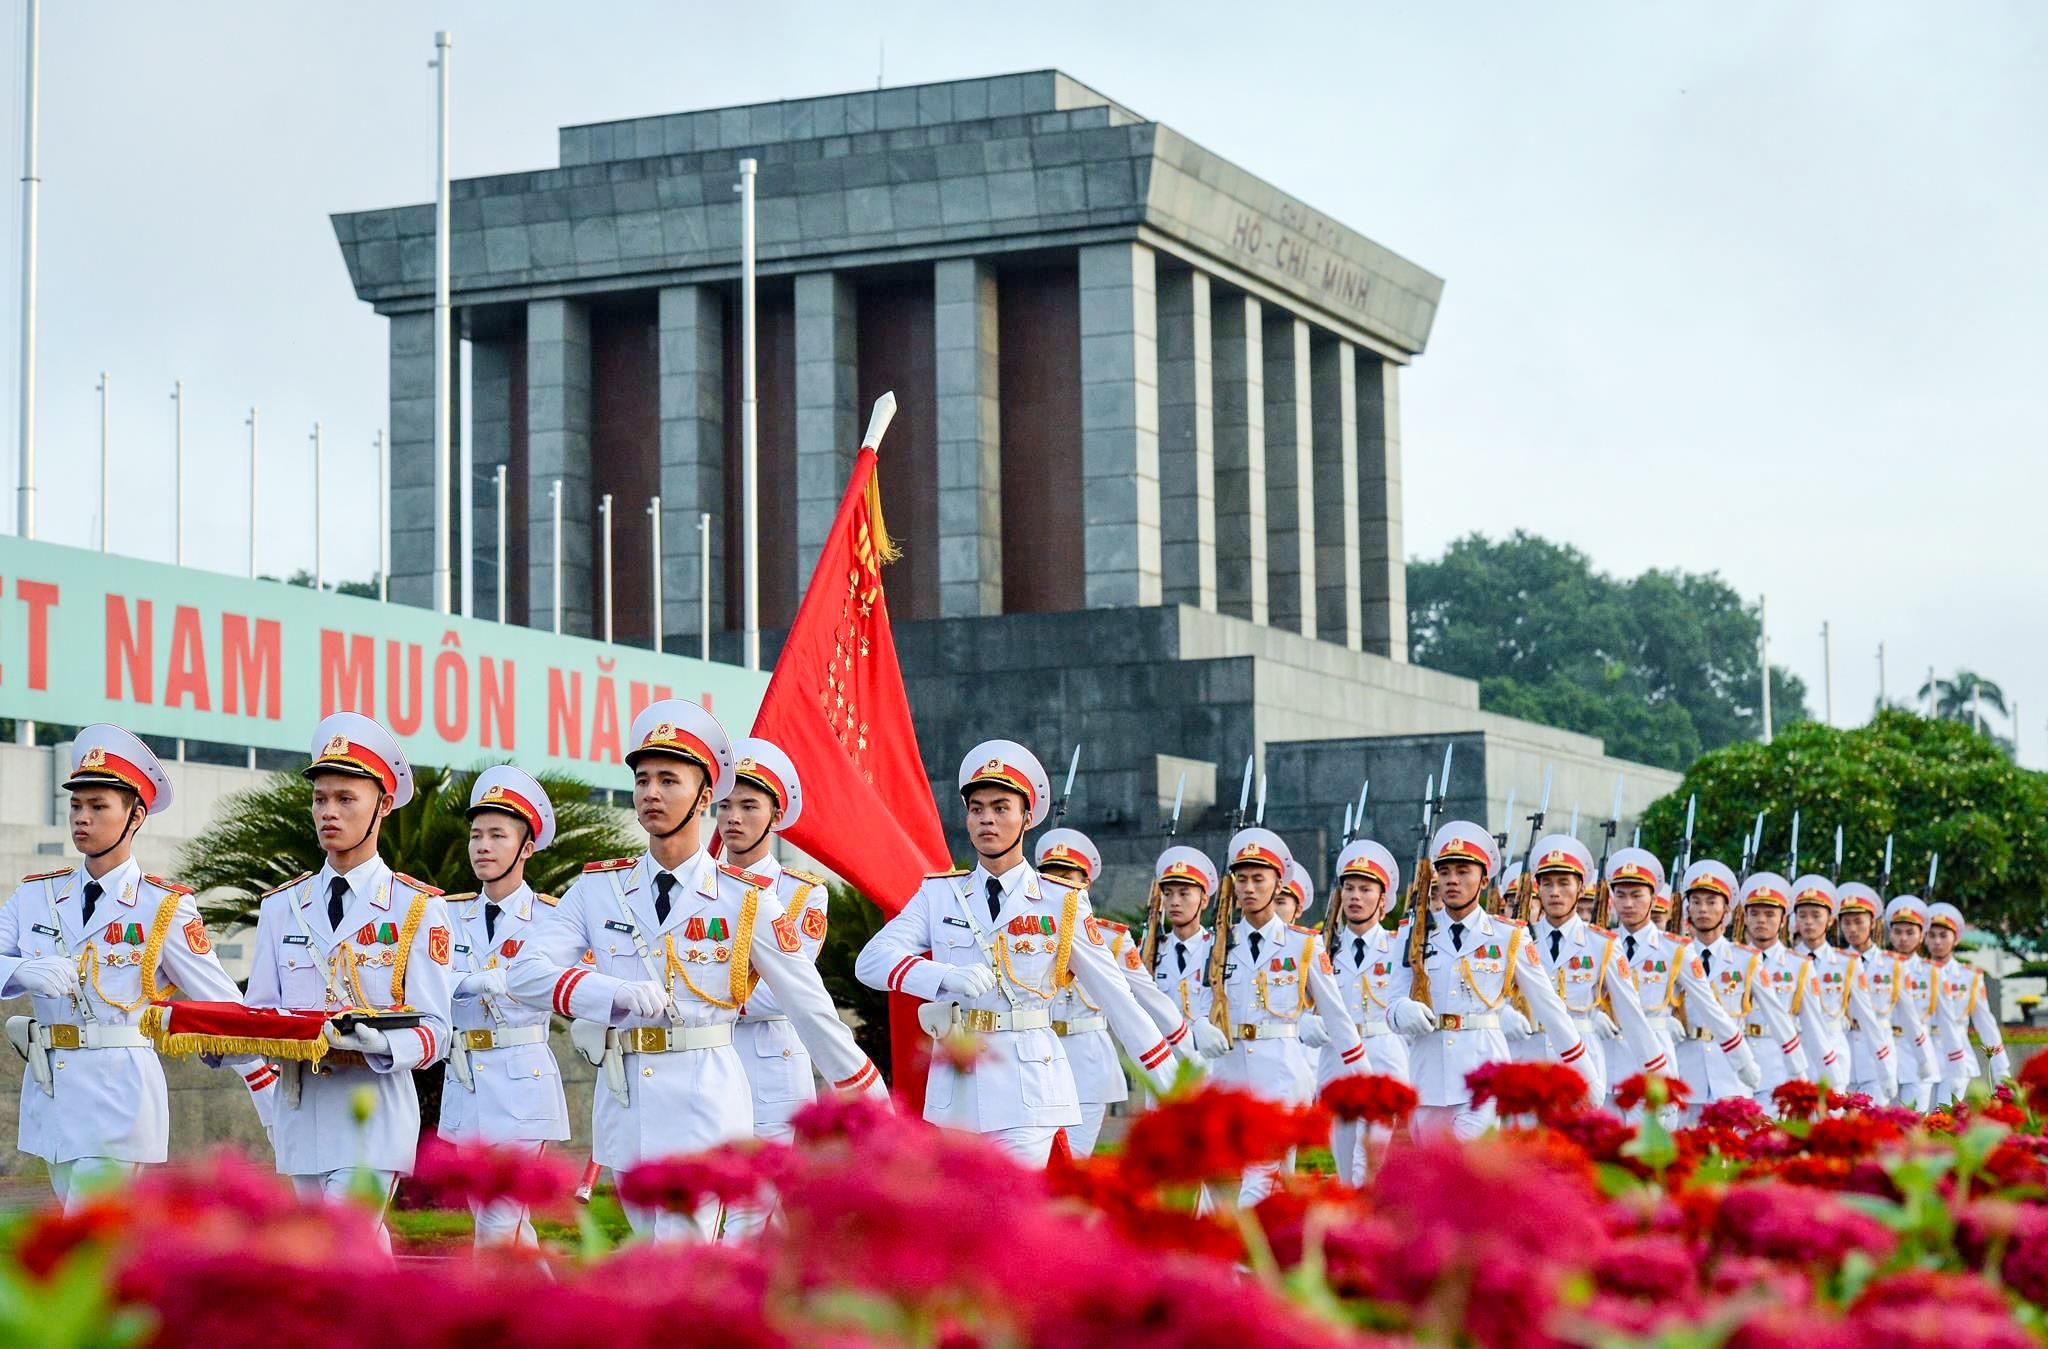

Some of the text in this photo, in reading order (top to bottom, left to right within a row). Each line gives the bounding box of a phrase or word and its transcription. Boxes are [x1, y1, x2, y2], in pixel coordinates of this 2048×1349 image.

[0, 576, 59, 691] T
[105, 593, 282, 721] NAM
[320, 628, 515, 751] MUÔN
